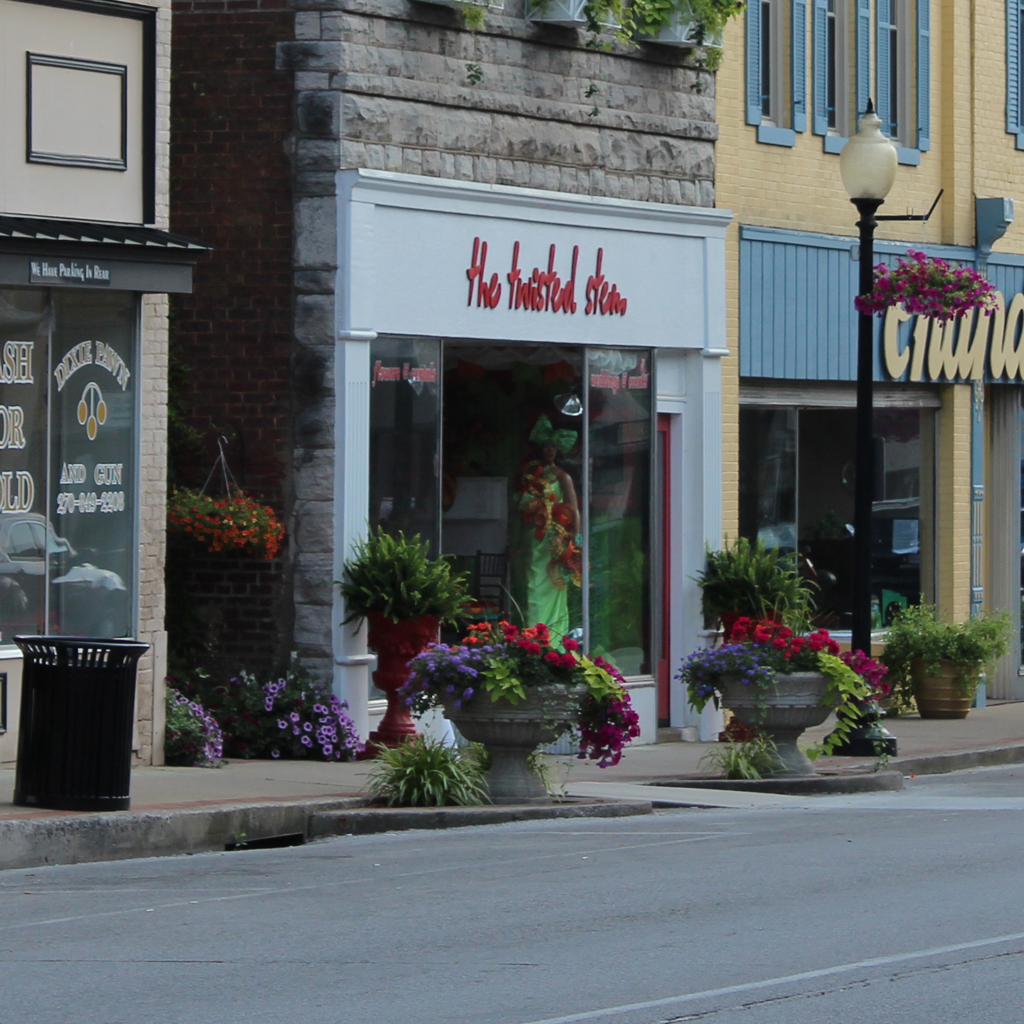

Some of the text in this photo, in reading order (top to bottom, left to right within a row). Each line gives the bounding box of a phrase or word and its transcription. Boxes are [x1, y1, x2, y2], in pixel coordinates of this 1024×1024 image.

[466, 236, 627, 316] the twisted stem
[53, 340, 131, 392] DIXIE PAWN
[60, 462, 123, 485] AND GUN
